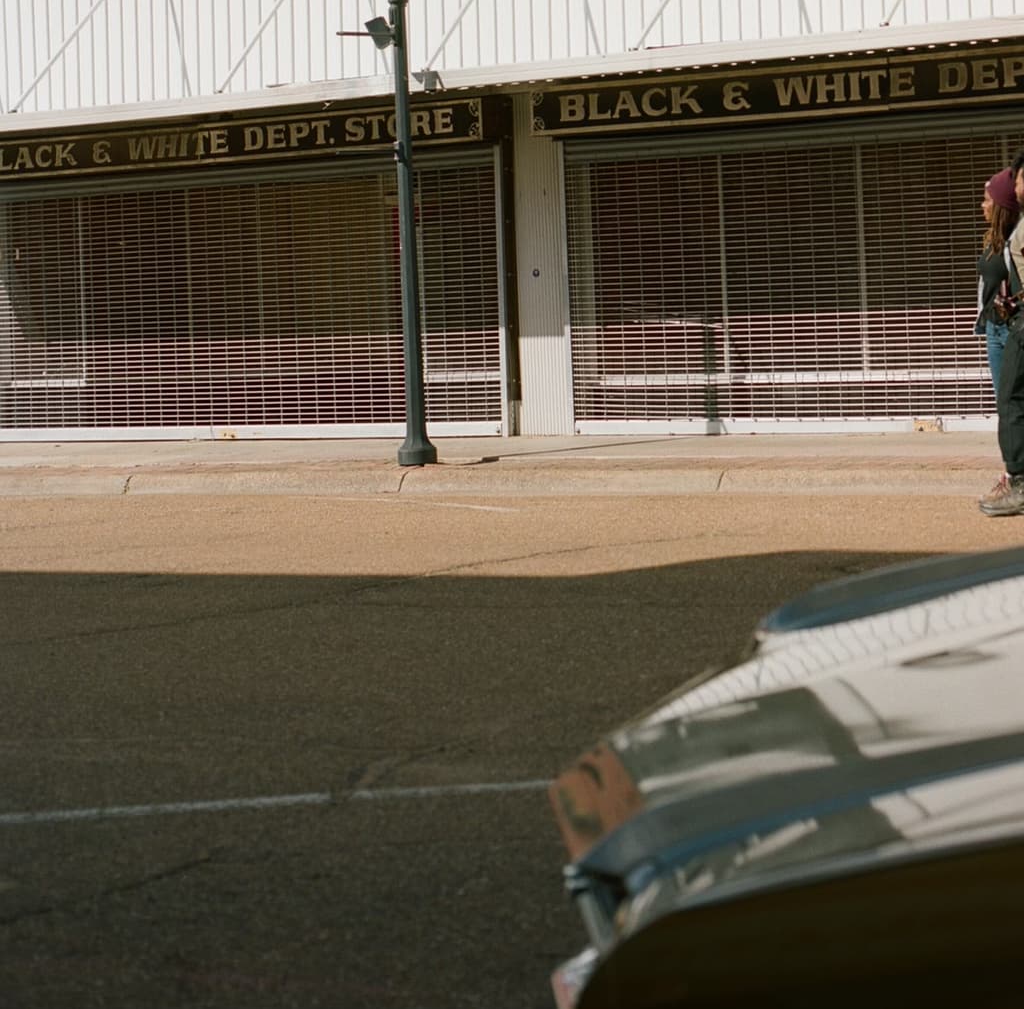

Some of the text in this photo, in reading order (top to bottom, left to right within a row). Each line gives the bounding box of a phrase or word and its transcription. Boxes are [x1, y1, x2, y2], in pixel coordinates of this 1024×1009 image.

[559, 86, 702, 122] BLACK
[722, 82, 750, 111] &
[774, 66, 915, 106] WHITE
[92, 141, 112, 163] &
[128, 129, 229, 160] WHITE
[244, 120, 335, 151] DEPT.
